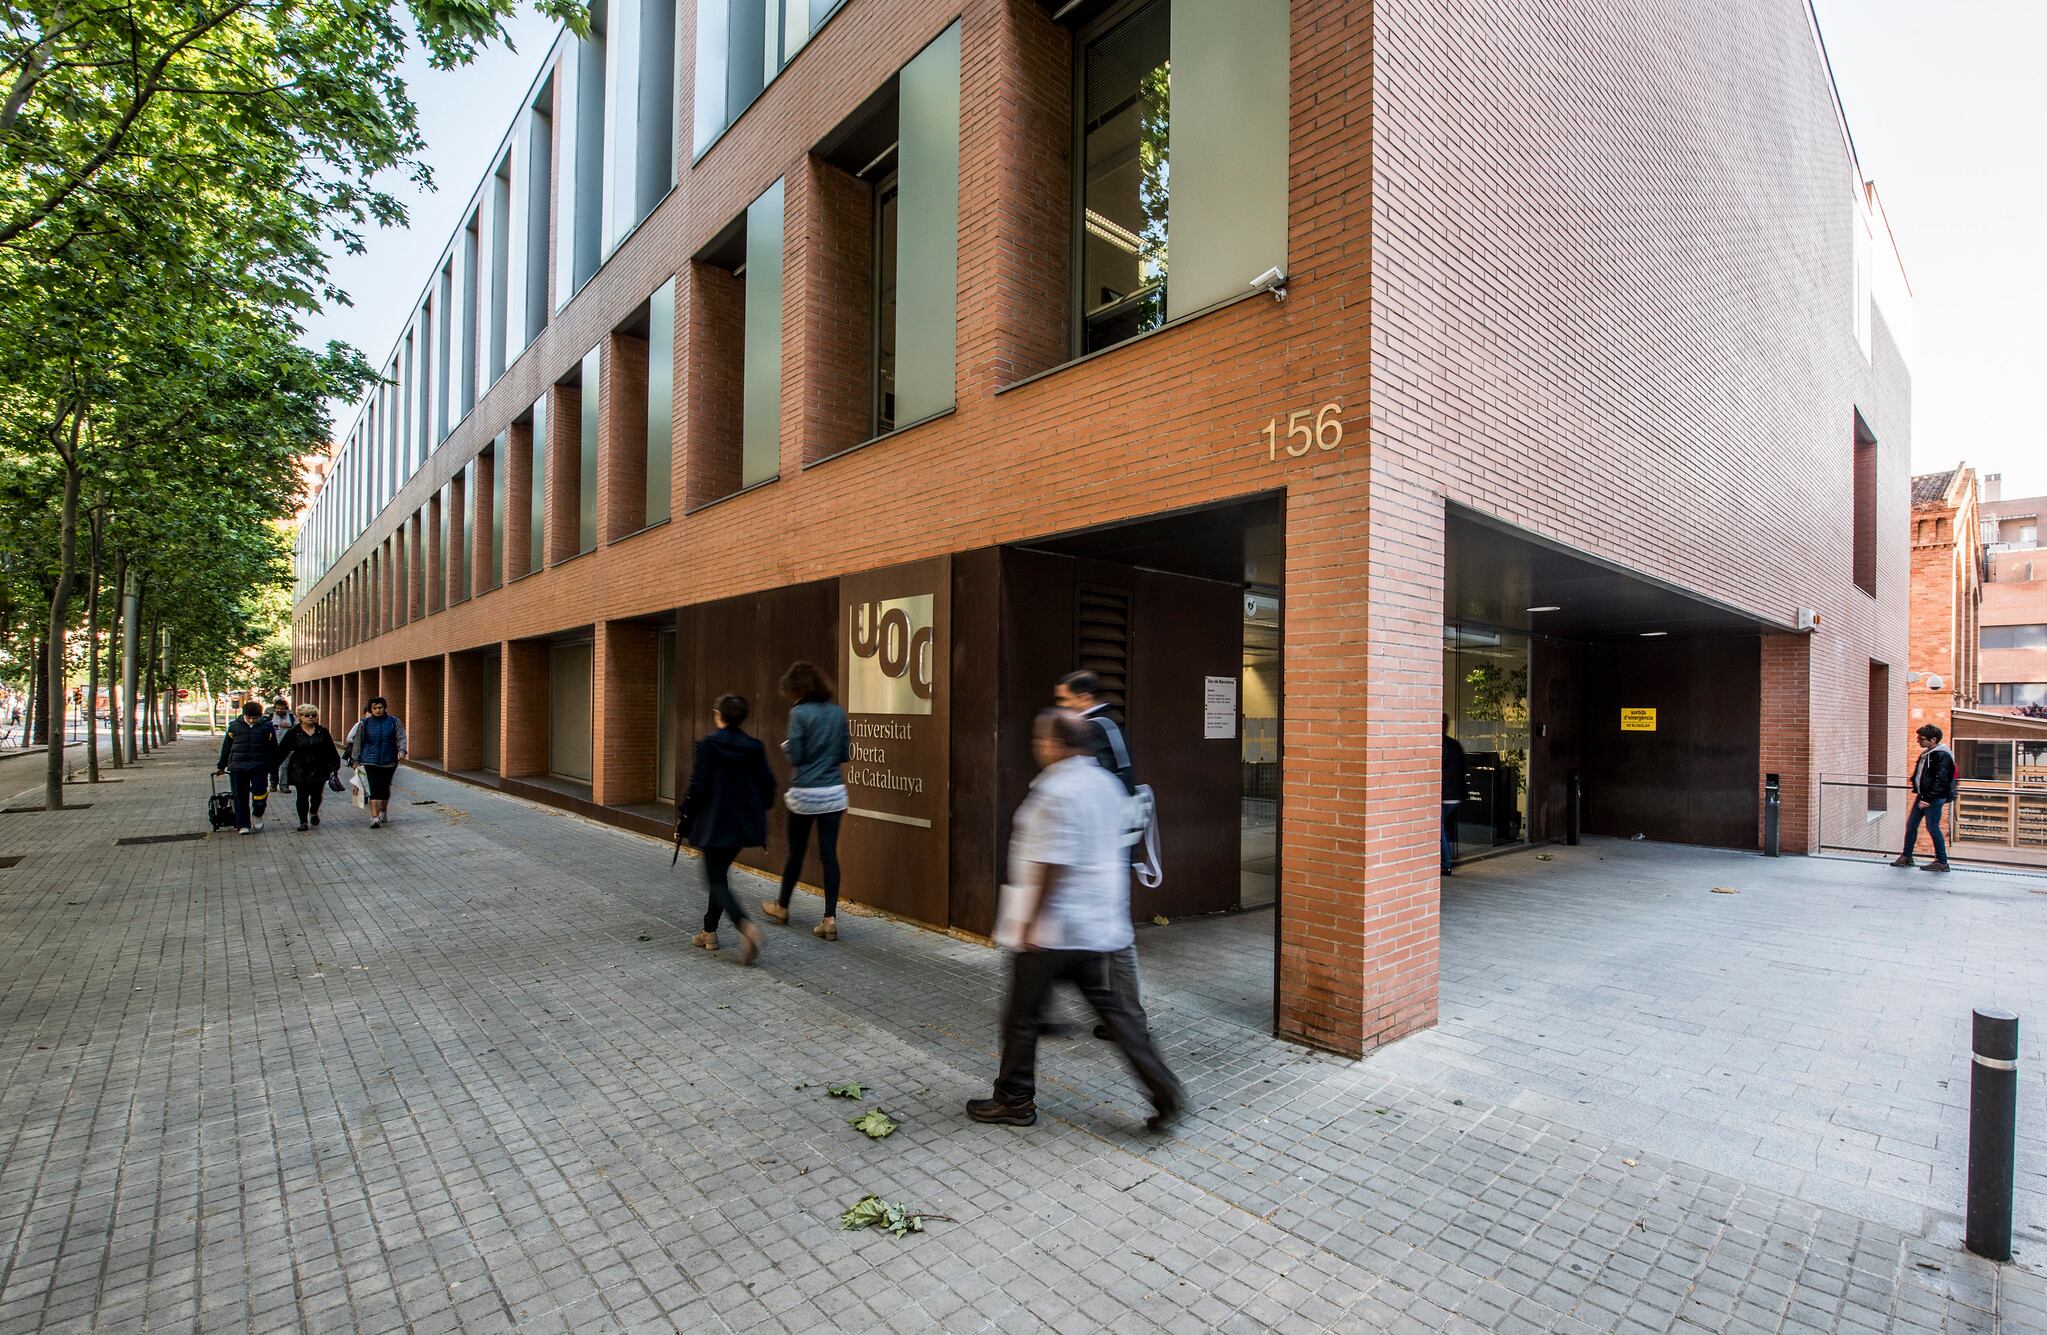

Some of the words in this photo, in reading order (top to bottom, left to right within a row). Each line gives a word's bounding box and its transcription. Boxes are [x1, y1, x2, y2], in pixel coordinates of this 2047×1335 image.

[1262, 403, 1343, 461] 156
[849, 719, 912, 740] Universitat
[848, 742, 886, 764] Oberta
[847, 765, 861, 785] de
[862, 767, 923, 797] Catalunya
